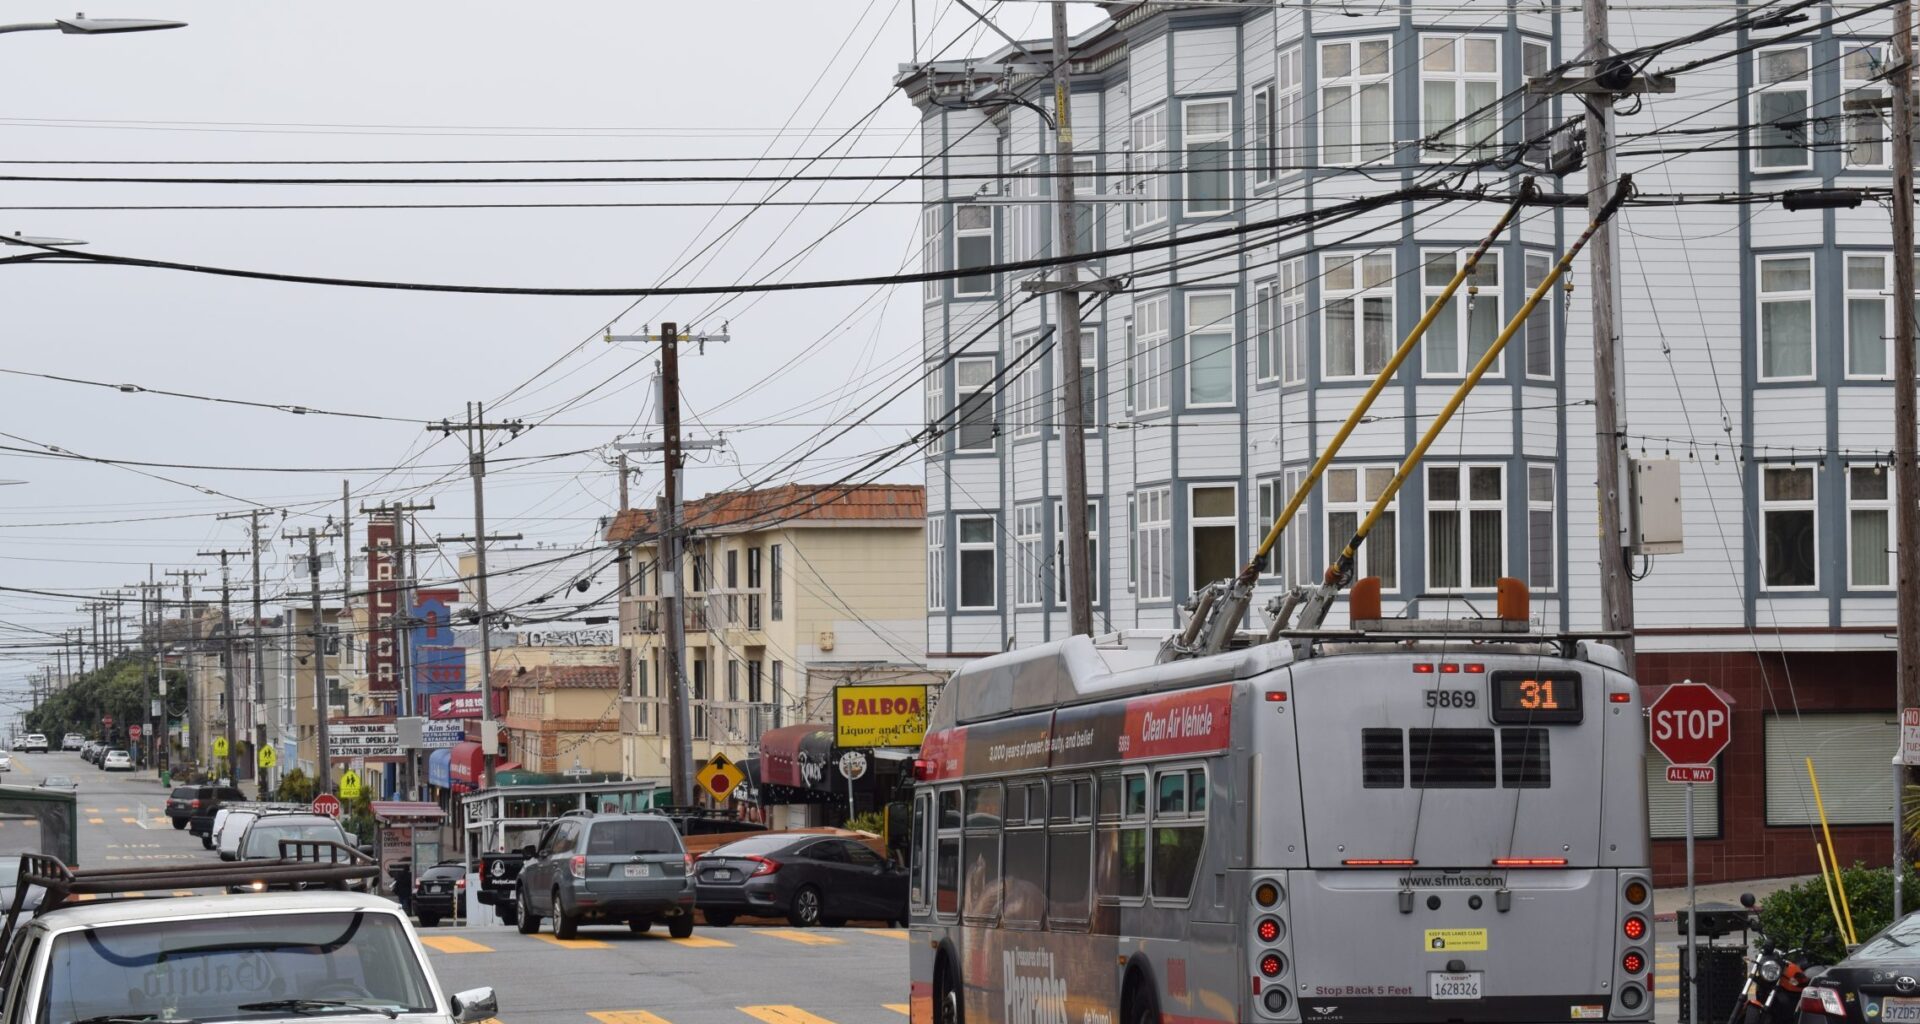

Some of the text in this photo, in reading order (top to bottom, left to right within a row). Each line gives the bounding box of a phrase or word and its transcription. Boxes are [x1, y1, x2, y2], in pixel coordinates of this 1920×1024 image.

[1426, 690, 1476, 708] 5869
[1520, 680, 1557, 709] 31
[842, 697, 921, 716] BALBOA
[1142, 704, 1213, 742] Clean Air Vehicle
[1906, 710, 1919, 724] NO
[350, 725, 385, 733] YOUR NAME
[428, 724, 444, 732] Kim
[840, 725, 874, 737] Liquor
[879, 724, 900, 735] and
[1655, 709, 1724, 740] STOP
[365, 736, 386, 744] OPENS
[989, 744, 1006, 763] 3,000
[1005, 743, 1020, 762] years
[1065, 731, 1076, 749] and
[1076, 728, 1093, 747] belief
[1670, 769, 1711, 779] ALL WAY
[314, 804, 339, 815] STOP
[1399, 875, 1504, 887] www.sfmta.com
[1002, 950, 1067, 1024] Pharaohs
[1315, 986, 1412, 996] Stop Back 5 Feet
[1434, 983, 1478, 996] 1628326
